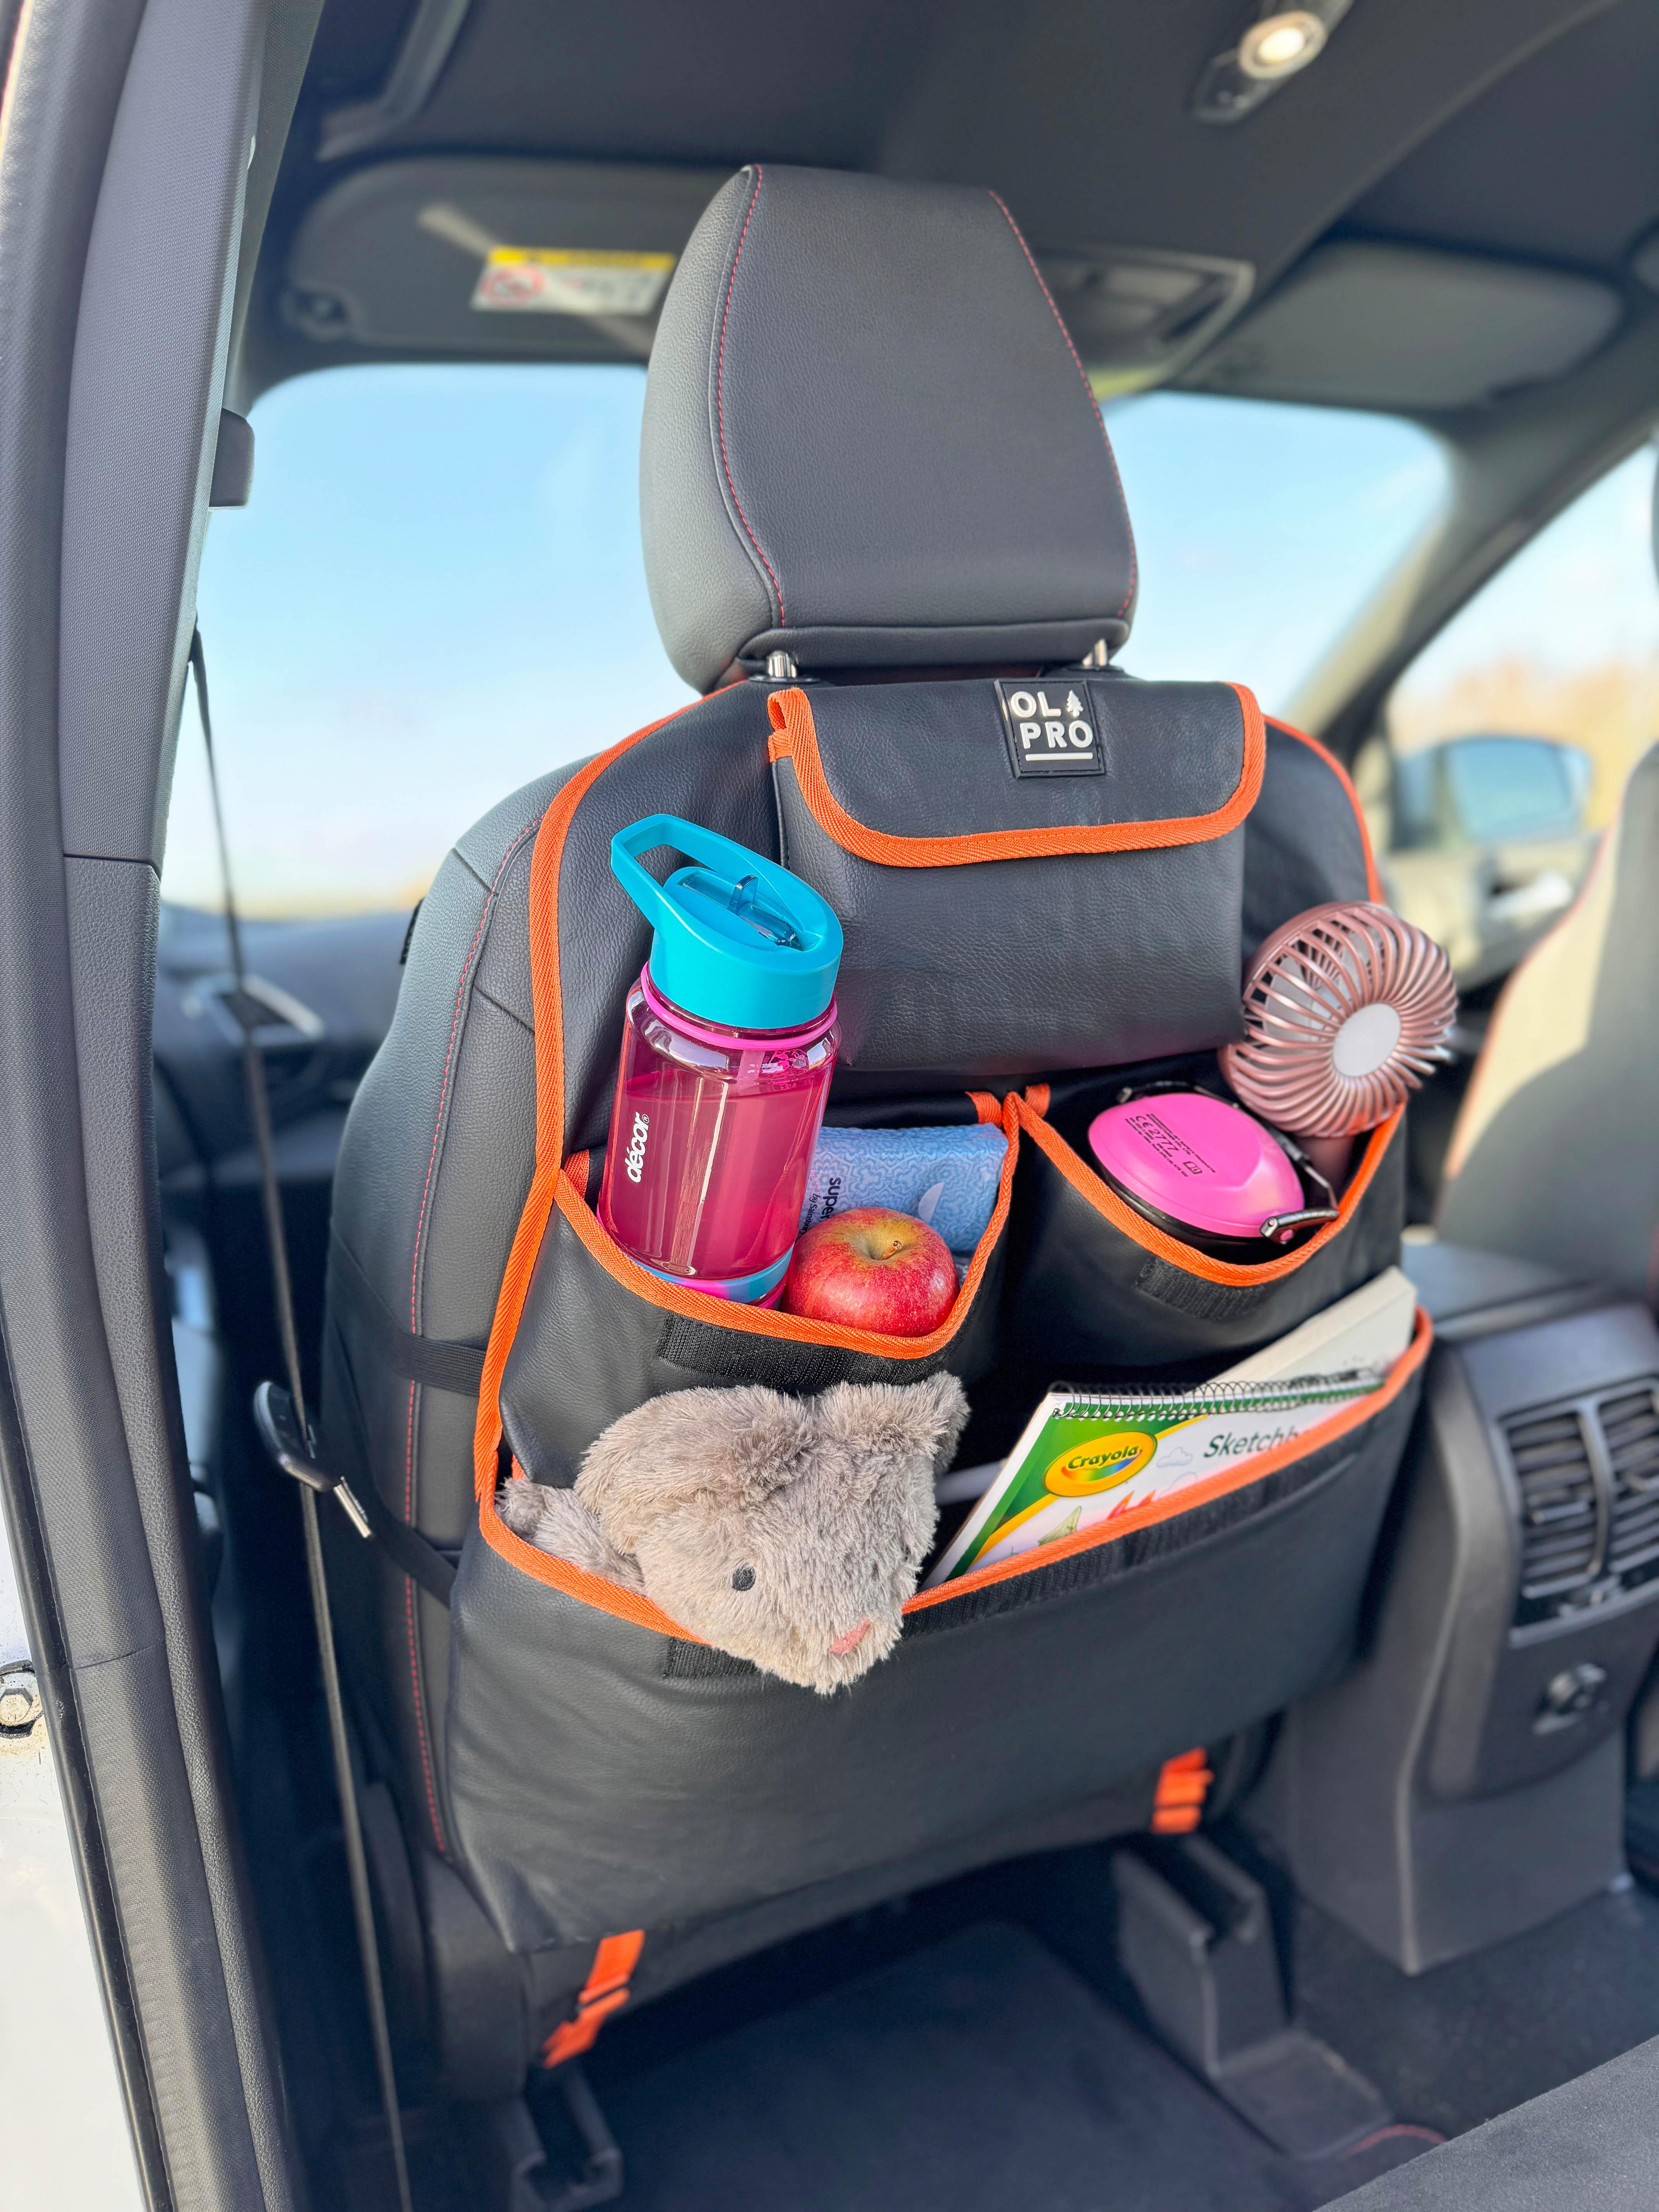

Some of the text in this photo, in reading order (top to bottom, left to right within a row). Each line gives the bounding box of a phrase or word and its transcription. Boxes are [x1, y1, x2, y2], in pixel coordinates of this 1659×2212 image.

[1011, 691, 1061, 718] OL
[1019, 720, 1093, 749] PRO
[1148, 1129, 1179, 1151] 2777
[809, 1193, 821, 1203] by
[820, 1177, 841, 1219] super
[1068, 1445, 1139, 1469] Crayola
